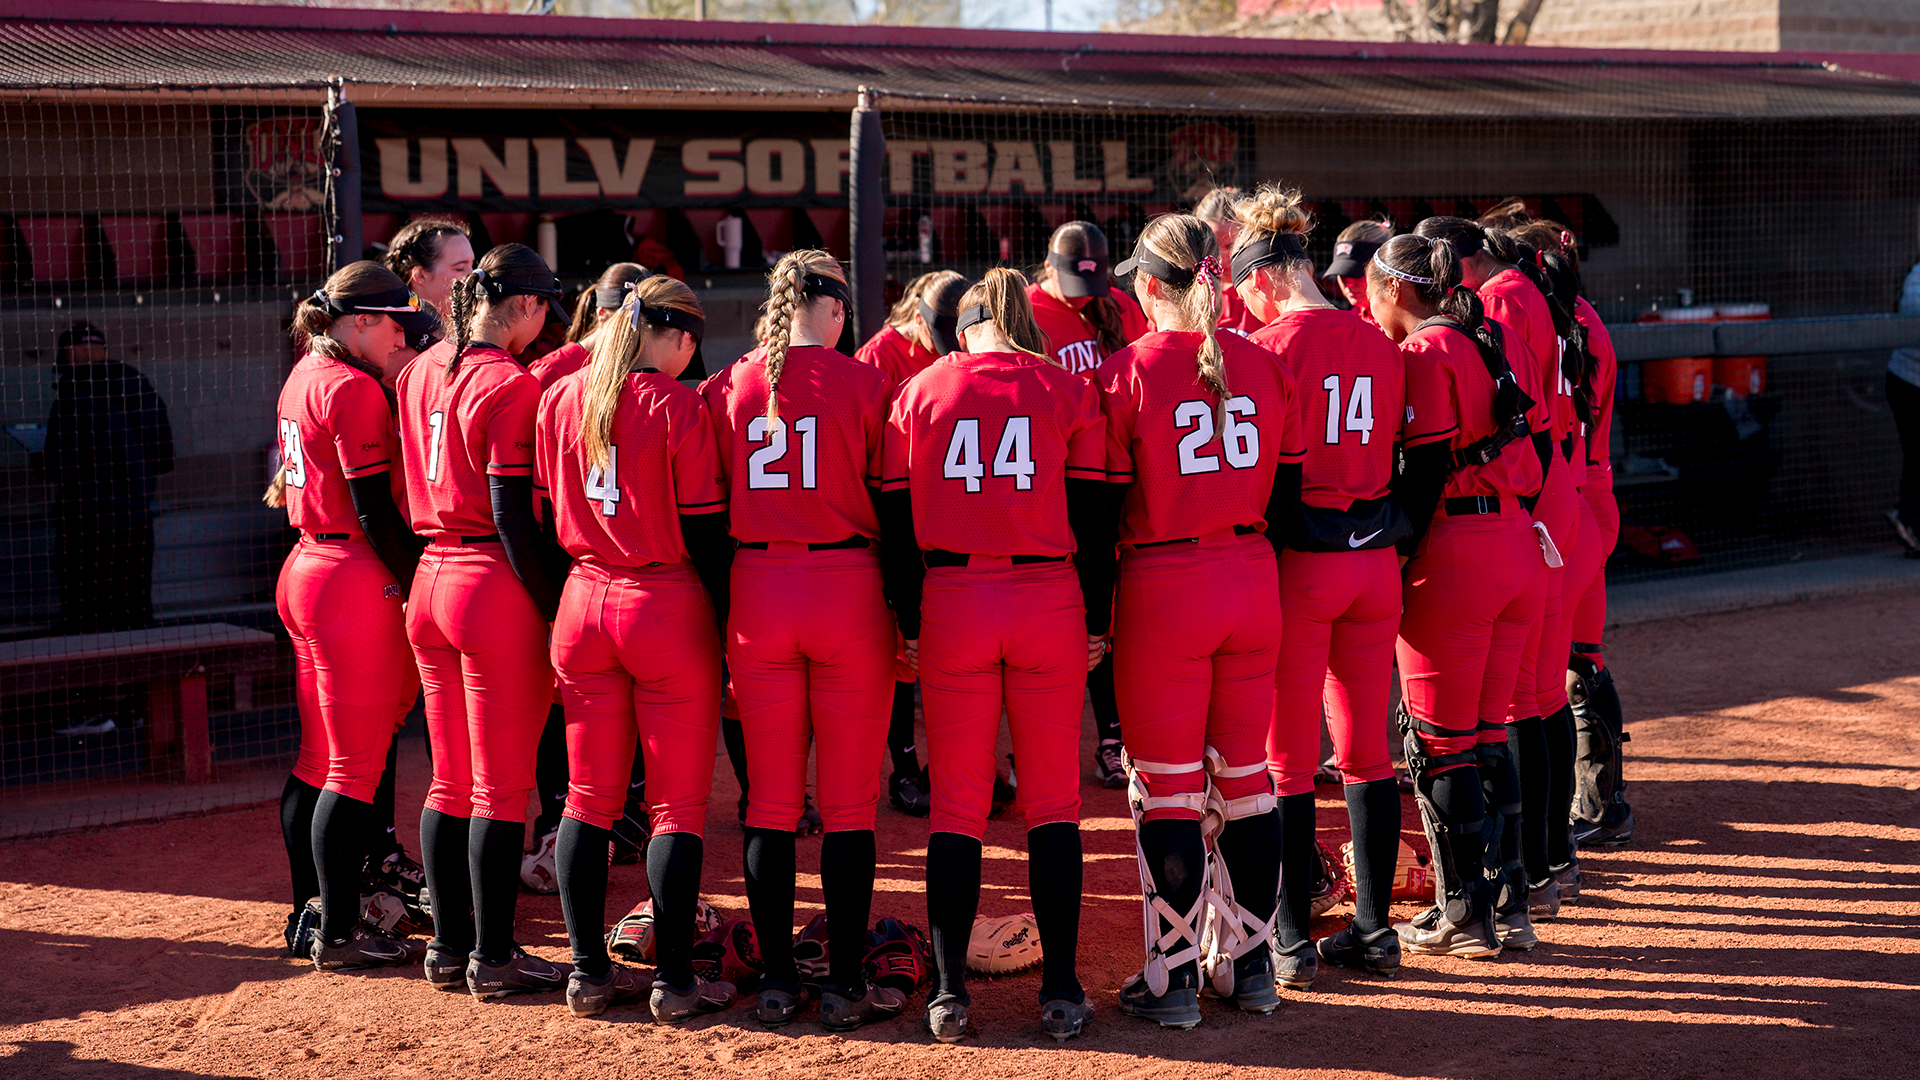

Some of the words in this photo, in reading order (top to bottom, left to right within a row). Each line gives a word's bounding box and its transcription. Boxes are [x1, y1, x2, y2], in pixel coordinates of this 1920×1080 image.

[250, 118, 325, 170] UNL
[374, 137, 655, 199] UNLV
[681, 137, 1154, 197] SOFTBALL
[427, 410, 444, 482] 1
[1173, 395, 1261, 476] 26
[1322, 373, 1375, 446] 14
[585, 444, 621, 518] 4
[747, 415, 818, 490] 21
[943, 415, 1036, 493] 44
